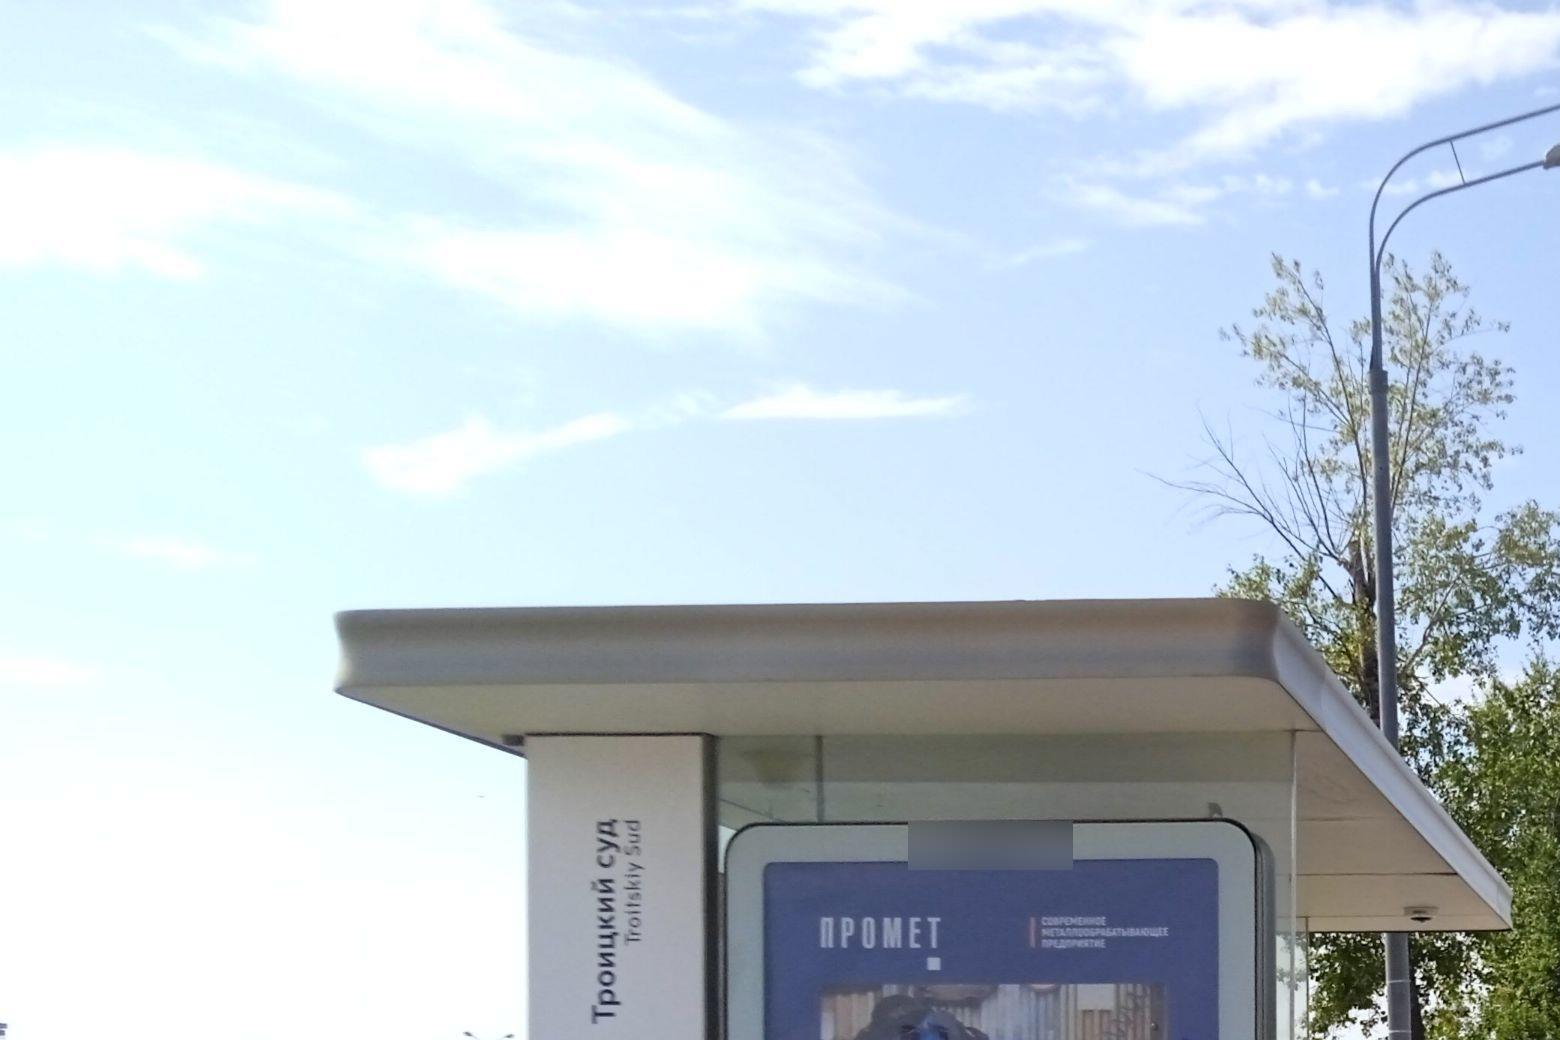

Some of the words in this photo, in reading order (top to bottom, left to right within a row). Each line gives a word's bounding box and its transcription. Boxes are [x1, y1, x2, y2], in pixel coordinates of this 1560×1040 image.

[596, 819, 620, 868] суд
[623, 820, 642, 856] Sud
[624, 862, 645, 947] Troitskiy
[591, 878, 621, 1024] Троицкий
[819, 917, 942, 949] ПРОМЕТ
